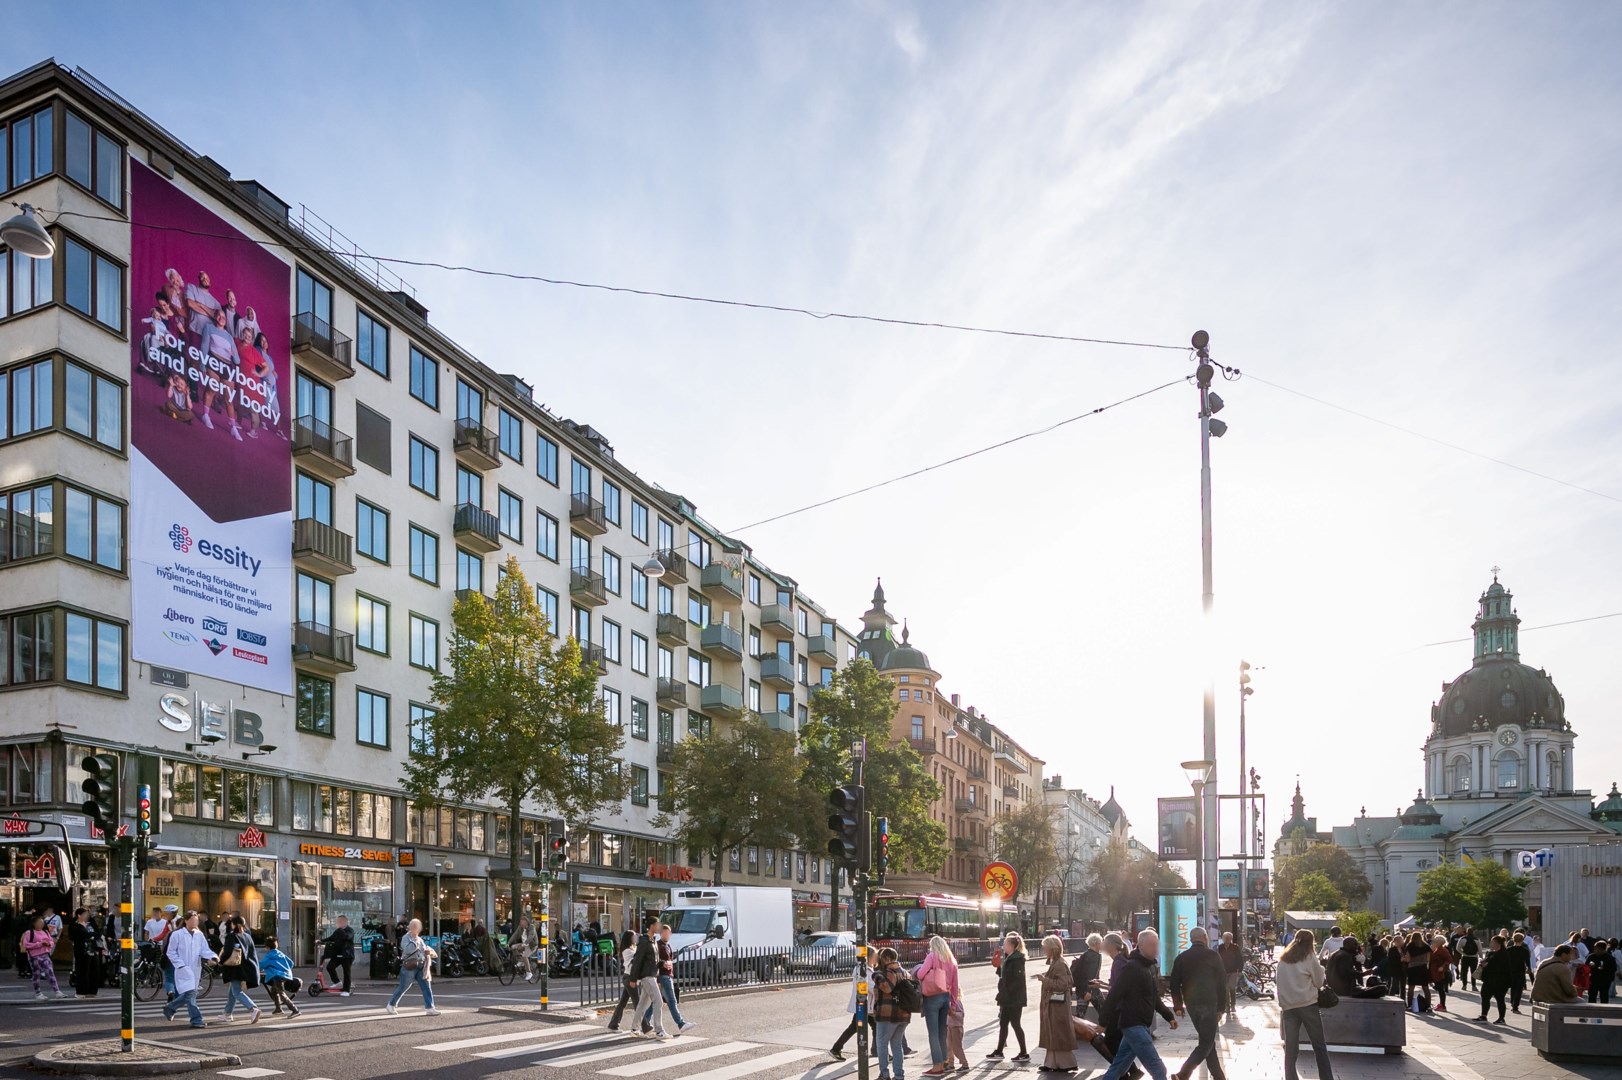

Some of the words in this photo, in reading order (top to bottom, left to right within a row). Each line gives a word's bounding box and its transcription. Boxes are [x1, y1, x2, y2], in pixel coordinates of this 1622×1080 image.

[155, 331, 185, 352] For
[188, 346, 276, 403] everybody
[149, 347, 184, 375] and
[188, 367, 236, 403] every
[240, 391, 280, 425] body
[198, 539, 261, 577] essity
[156, 567, 184, 583] hygien
[186, 576, 201, 589] och
[202, 579, 223, 596] hälsa
[224, 588, 235, 599] för
[236, 595, 246, 603] en
[247, 596, 272, 611] miljard
[175, 562, 195, 577] Varje
[196, 570, 211, 583] dag
[213, 575, 249, 594] förbättrar
[250, 588, 257, 597] vi
[173, 584, 214, 602] människor
[219, 597, 233, 609] 150
[235, 602, 258, 617] länder
[163, 607, 194, 625] Libero
[203, 620, 227, 635] TORK
[170, 631, 190, 642] TENA
[235, 649, 265, 664] Leukoplast
[158, 693, 264, 747] SEB
[91, 820, 130, 842] MX
[239, 825, 264, 848] MAX
[24, 852, 57, 879] MA
[299, 843, 393, 862] FITNESS24SEVEN
[156, 877, 173, 887] FISH
[1177, 914, 1189, 956] NART
